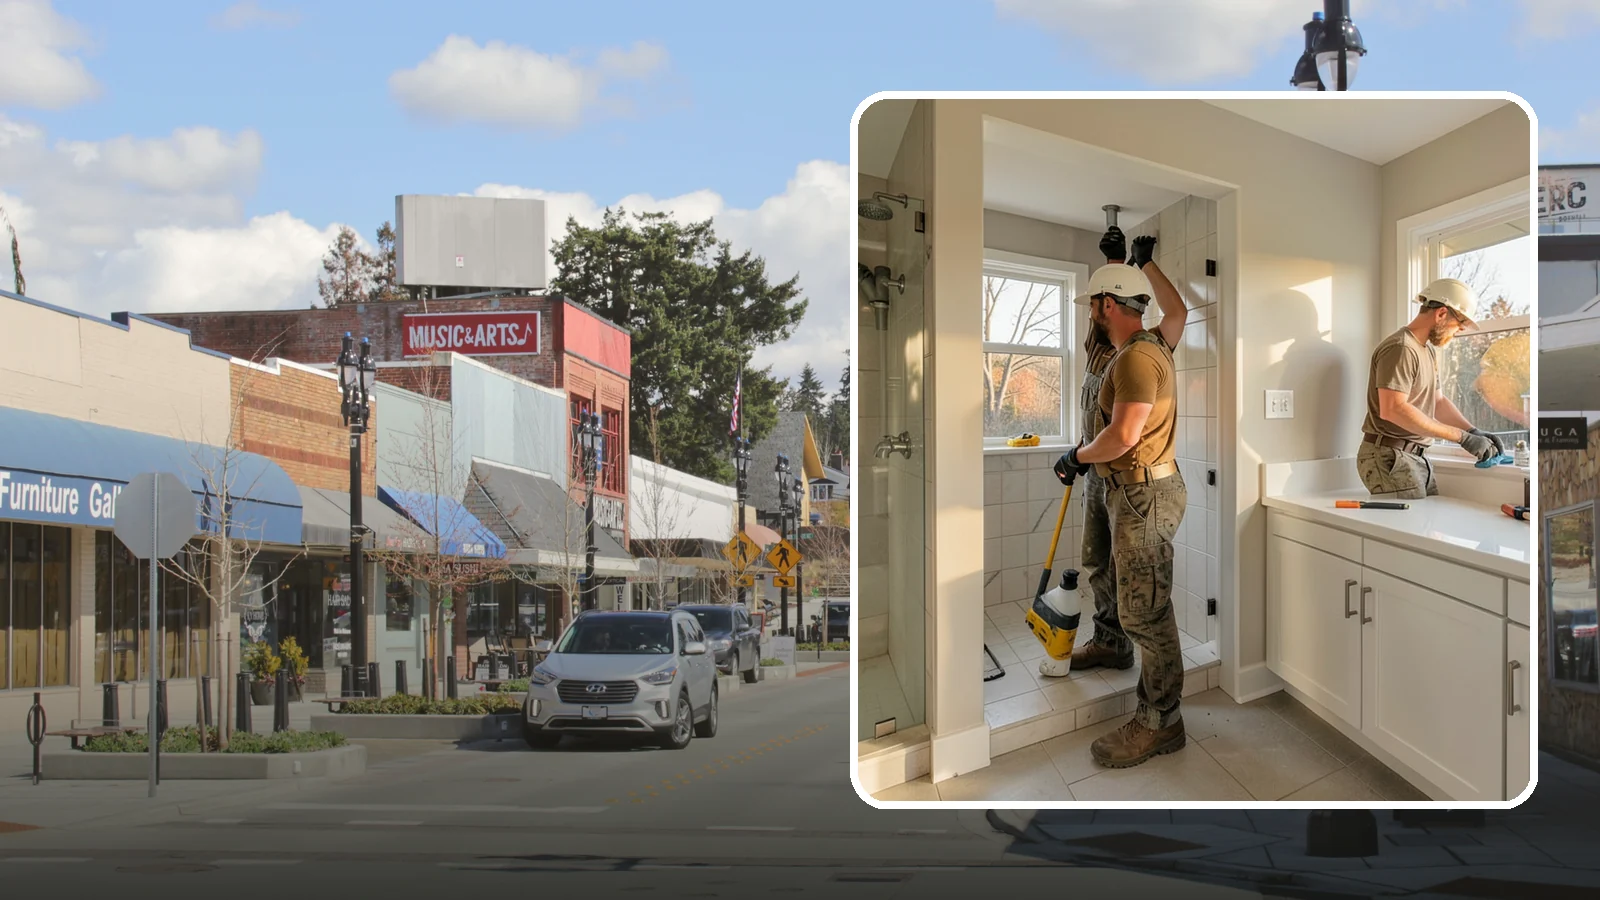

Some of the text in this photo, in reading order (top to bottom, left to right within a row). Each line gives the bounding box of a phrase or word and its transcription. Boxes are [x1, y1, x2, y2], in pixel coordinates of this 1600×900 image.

[0, 471, 122, 519] Furniture Gal
[453, 563, 479, 575] SUSHI
